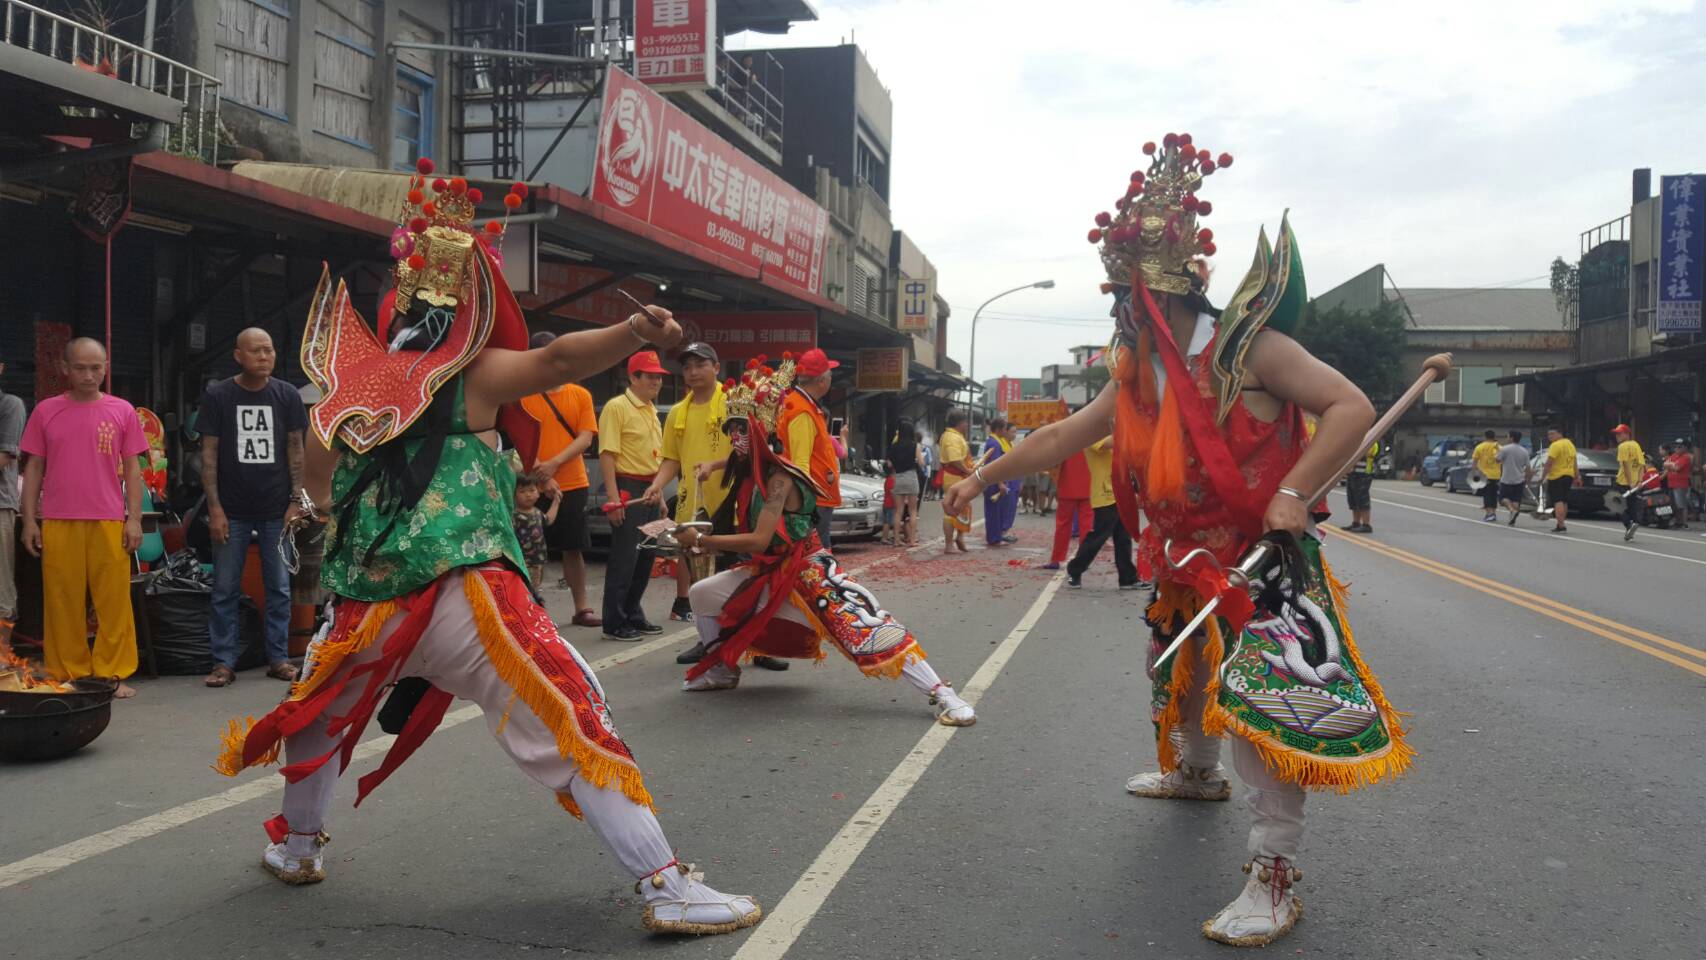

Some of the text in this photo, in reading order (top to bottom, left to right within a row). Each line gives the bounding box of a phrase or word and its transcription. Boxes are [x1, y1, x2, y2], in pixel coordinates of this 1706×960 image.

[641, 33, 700, 45] 03-9955532
[662, 129, 790, 247] 中太汽車保修廠
[706, 221, 746, 252] 03-9955532
[905, 281, 926, 315] 中山
[241, 409, 268, 431] CA
